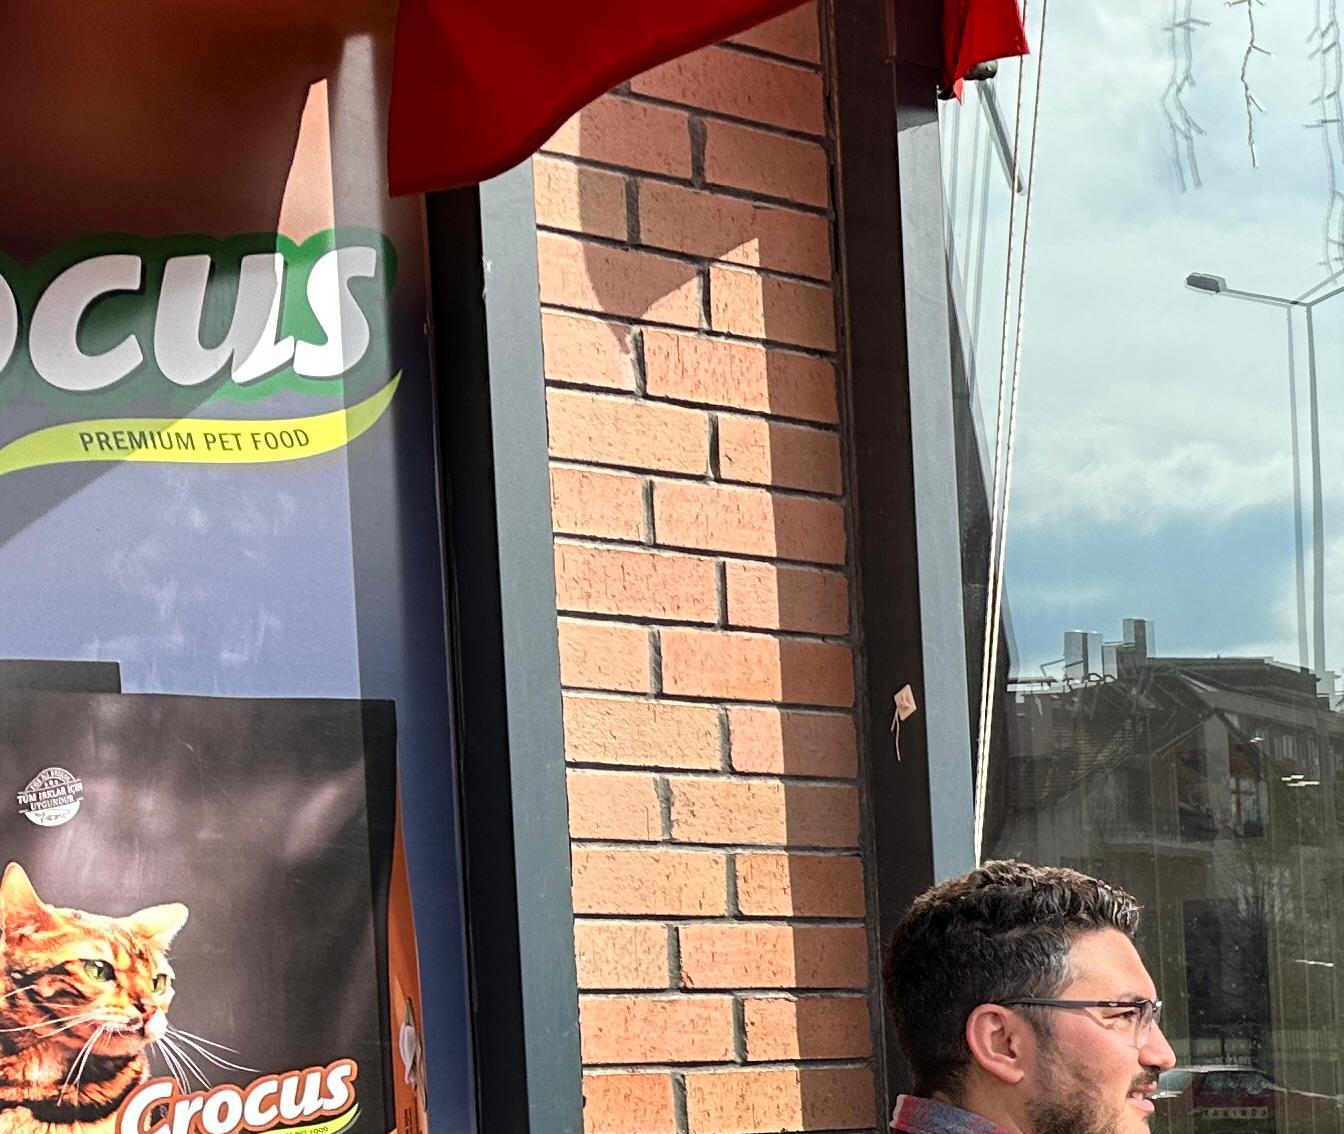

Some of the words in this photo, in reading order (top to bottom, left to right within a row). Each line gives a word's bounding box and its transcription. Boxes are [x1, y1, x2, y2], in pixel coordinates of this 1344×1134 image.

[0, 246, 378, 392] cus
[79, 430, 196, 453] PREMIUM
[205, 431, 243, 452] PET
[252, 428, 311, 451] FOOD
